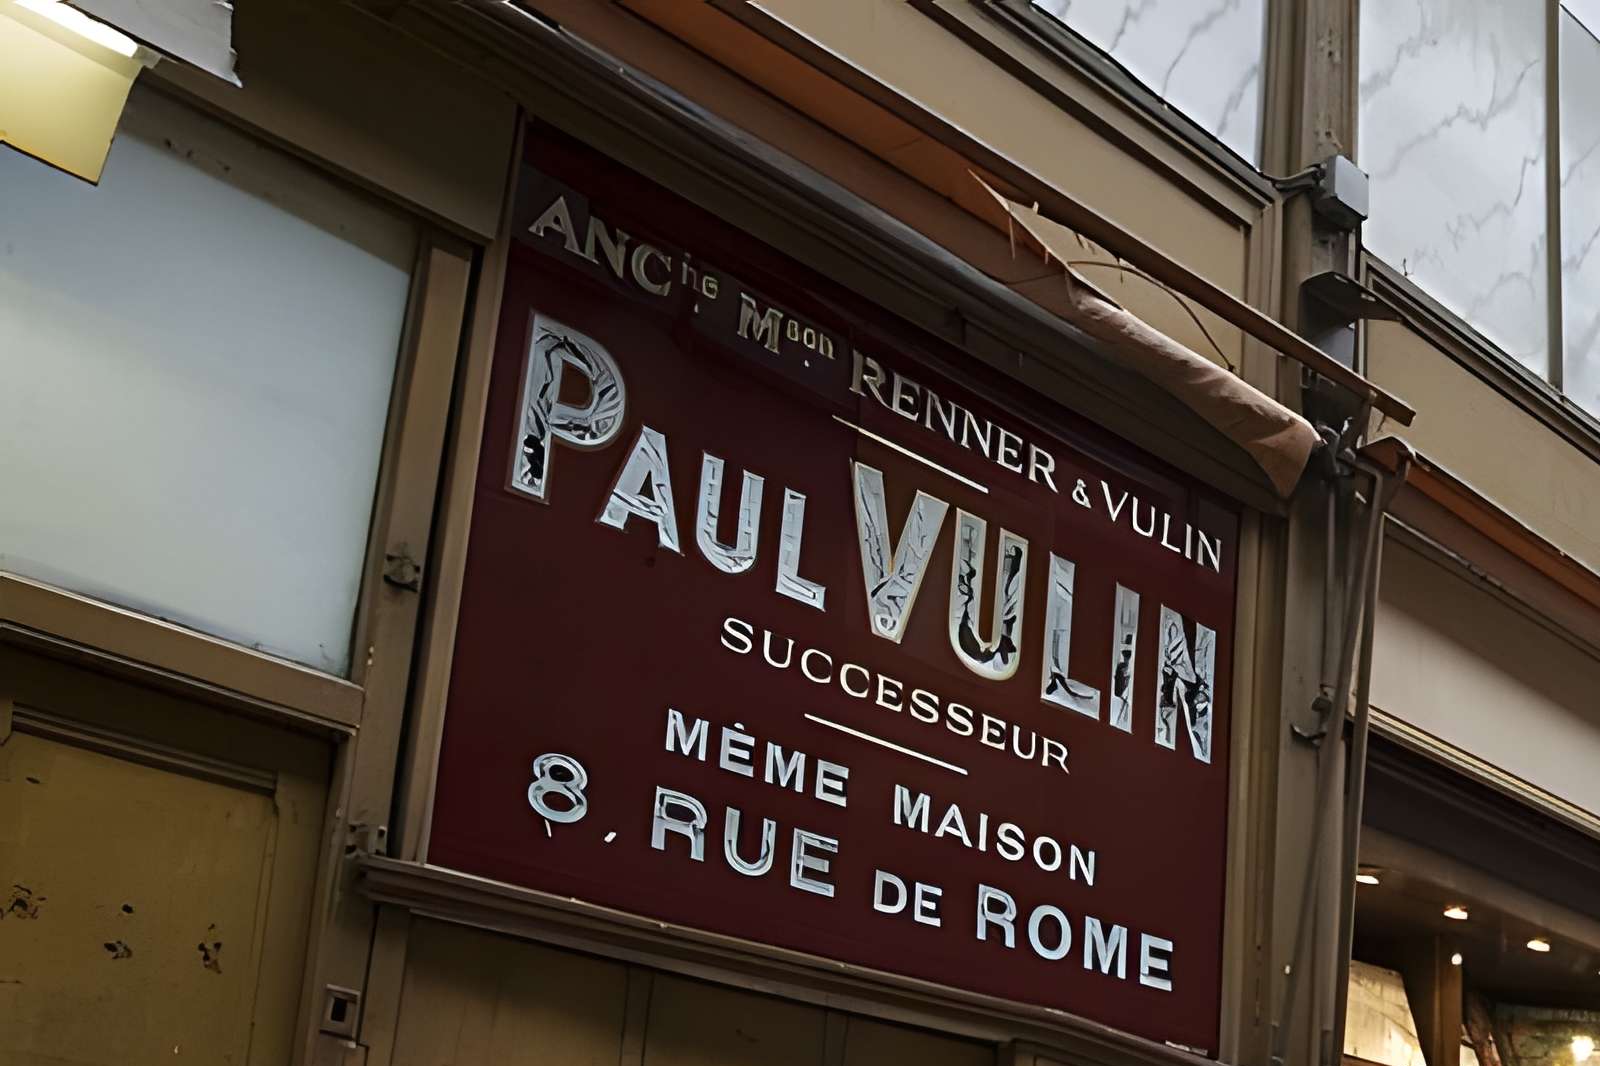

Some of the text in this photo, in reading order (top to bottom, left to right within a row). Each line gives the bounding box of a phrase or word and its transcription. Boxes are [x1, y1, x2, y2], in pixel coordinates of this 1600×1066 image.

[508, 312, 1217, 765] PAUL VULIN
[849, 349, 1058, 493] RENNER
[1072, 479, 1091, 509] &
[1100, 479, 1221, 573] VULIN
[720, 617, 1070, 773] SUCCESSEUR
[650, 785, 839, 897] RUE
[873, 870, 943, 927] DE
[975, 883, 1174, 991] ROME
[892, 784, 1097, 886] MAISON
